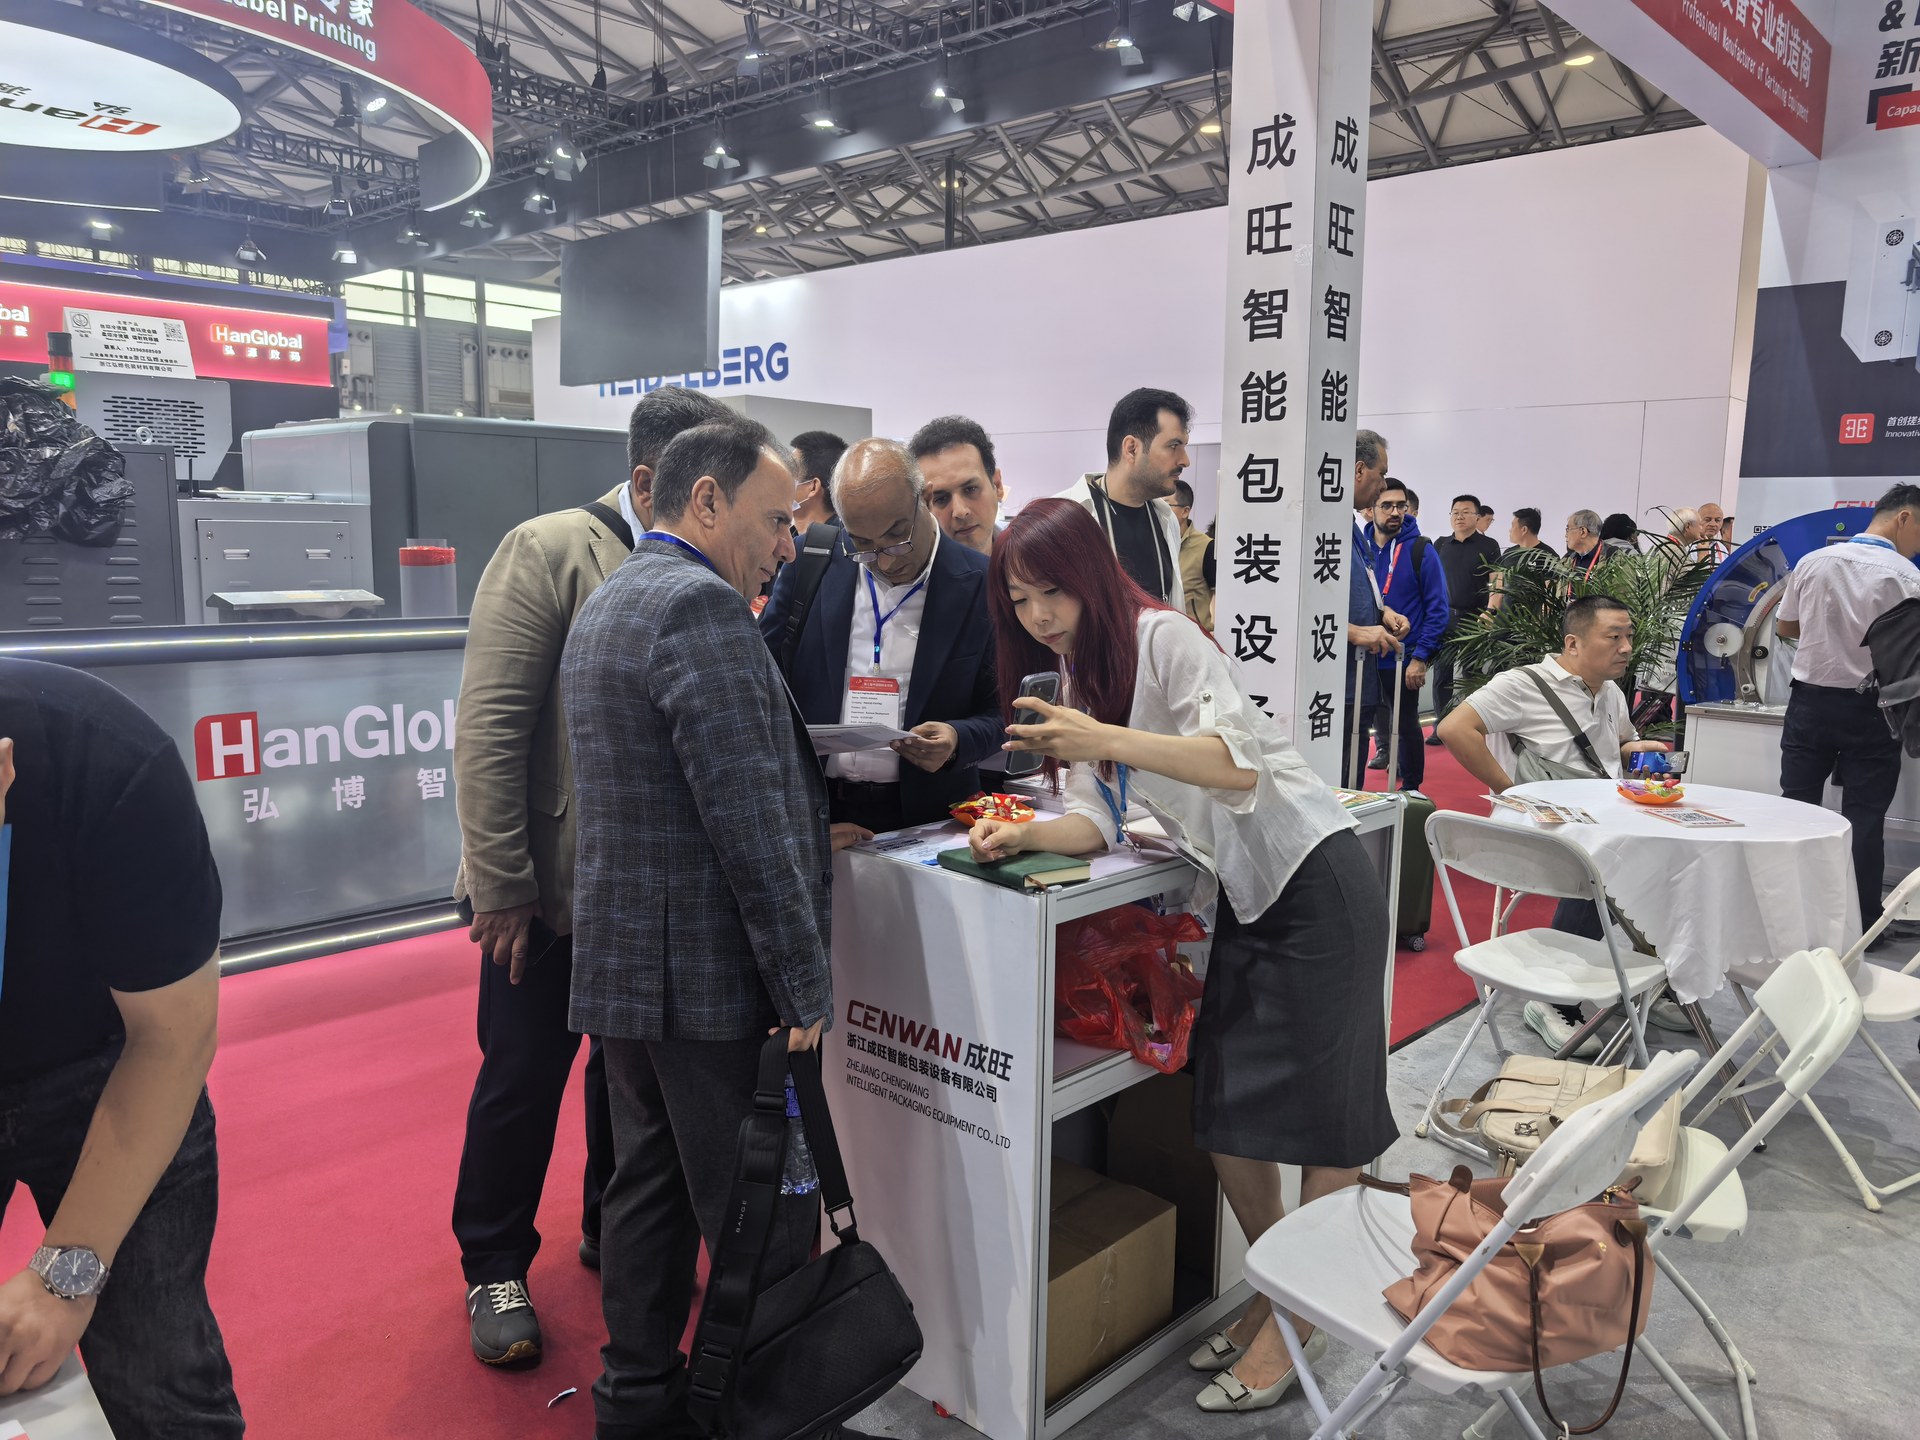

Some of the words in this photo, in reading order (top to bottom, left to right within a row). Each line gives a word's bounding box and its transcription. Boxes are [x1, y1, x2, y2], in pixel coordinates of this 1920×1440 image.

[294, 3, 376, 62] Printing
[1757, 62, 1764, 81] of
[210, 323, 303, 350] HanGlobal
[1308, 116, 1359, 741] 成旺智能包装设备
[846, 1031, 998, 1103] 浙江成旺智能包装设备有限公司
[847, 1000, 962, 1063] CENWAN
[963, 1042, 1013, 1082] 成旺
[846, 1057, 880, 1080] ZHEJIANG
[881, 1071, 930, 1099] CHENGWANG
[846, 1074, 888, 1099] INTELLIGENT
[888, 1090, 932, 1117] PACKAGING
[932, 1108, 977, 1136] EQUIPMENT
[995, 1134, 1011, 1149] LTD
